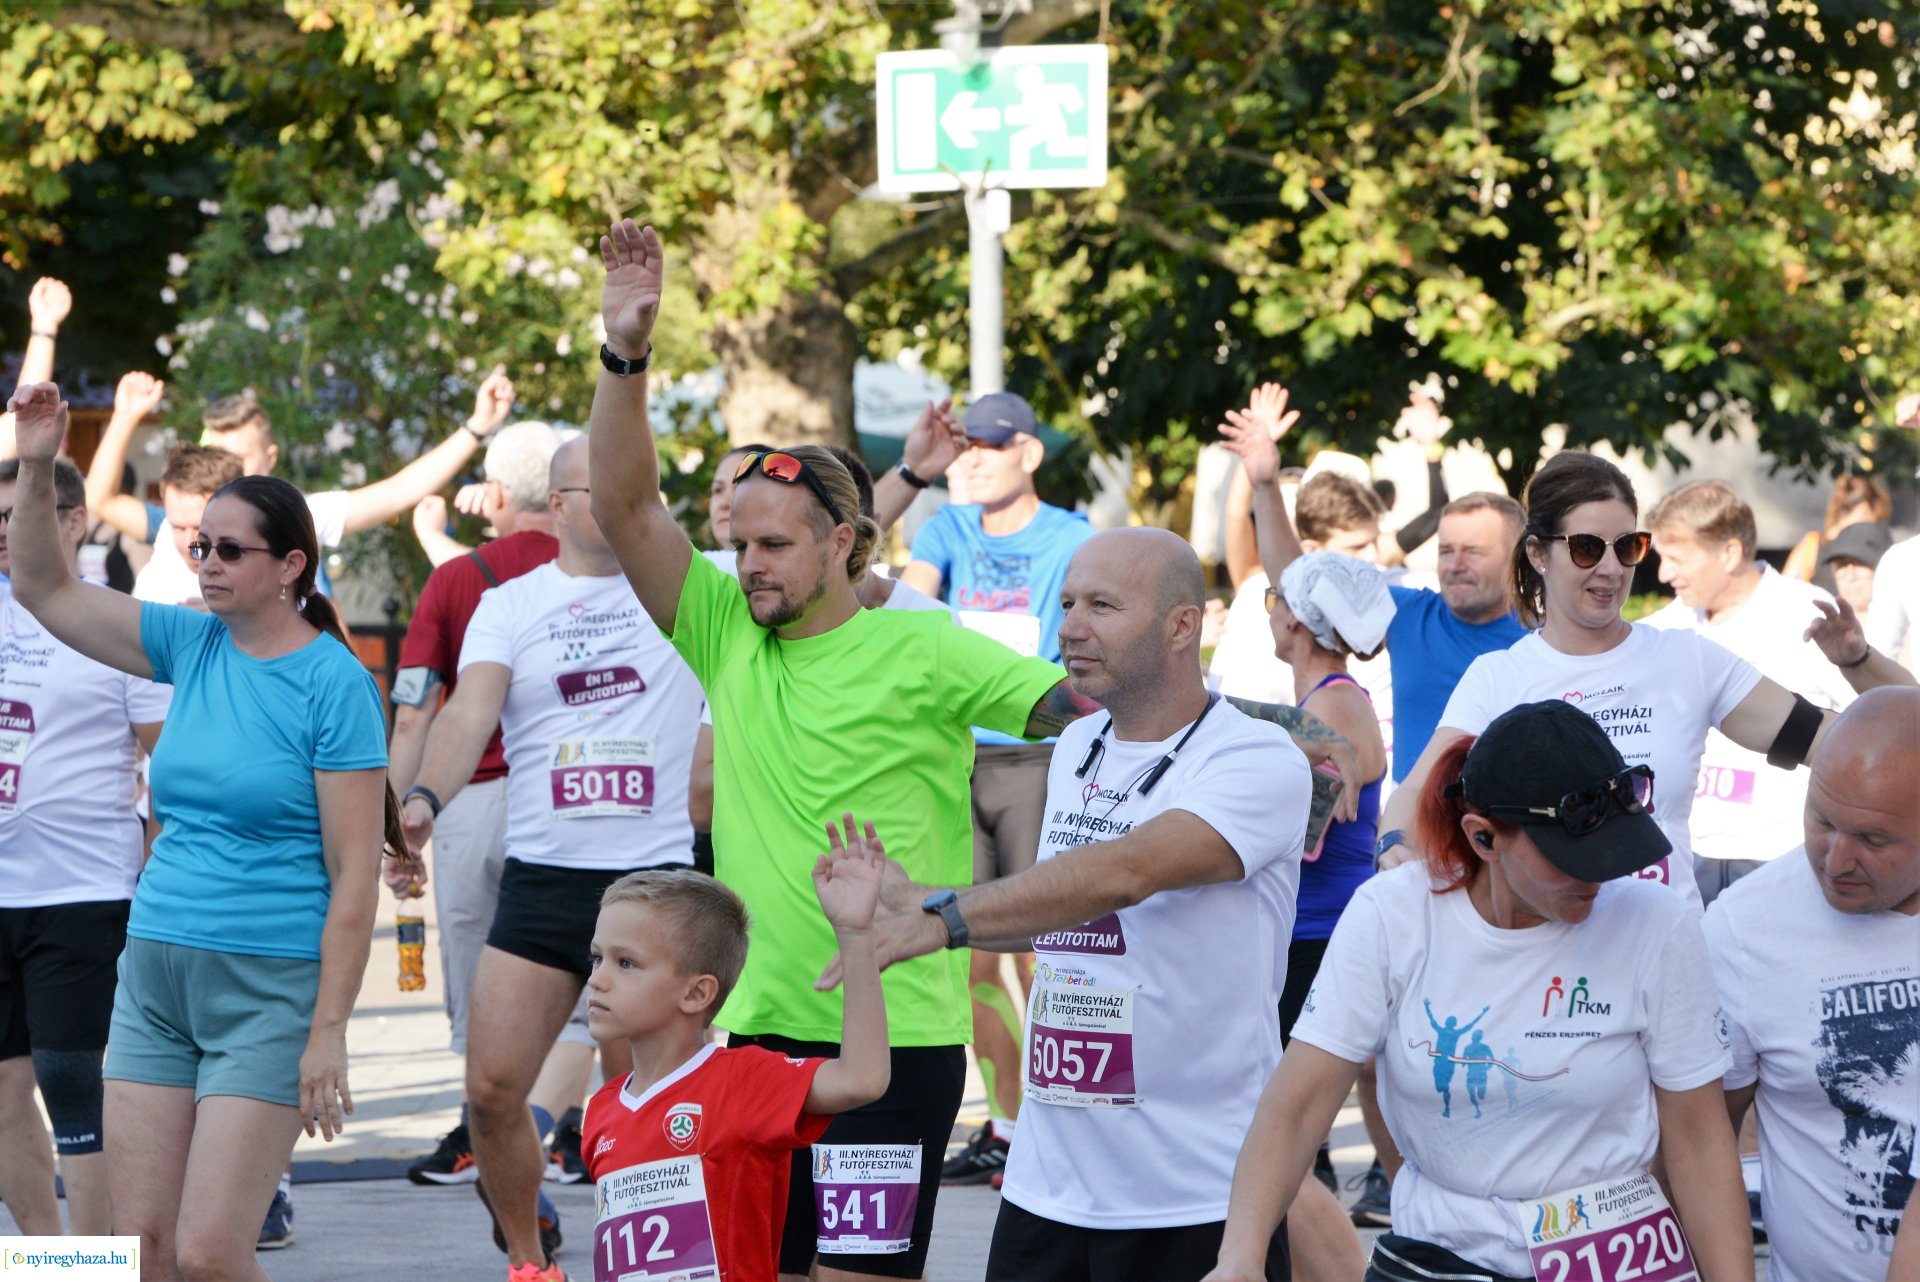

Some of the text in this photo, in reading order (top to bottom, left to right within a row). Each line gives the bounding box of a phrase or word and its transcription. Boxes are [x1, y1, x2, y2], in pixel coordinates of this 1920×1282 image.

[550, 621, 637, 641] FUTÓFESZTIVÁL
[585, 671, 615, 688] ÉN IS
[1584, 685, 1624, 699] MOZAIK
[567, 680, 641, 705] LEFUTOTTAM
[563, 769, 644, 802] 5018
[1052, 973, 1097, 987] Többet ad!
[1052, 1003, 1122, 1019] FUTÓFESZTIVÁL
[1577, 1000, 1611, 1016] TKM
[1820, 979, 1920, 1020] CALIFOR
[1525, 1031, 1602, 1039] PÉNZES ERZSÉBET
[1033, 1033, 1113, 1083] 5057
[839, 1158, 914, 1170] FUTÓFESZTIVÁL
[614, 1175, 691, 1201] FUTÓFESZTIVÁL
[1598, 1186, 1657, 1214] FUTÓFESZTIVÁL
[823, 1189, 886, 1230] 541
[602, 1214, 675, 1272] 112
[1540, 1216, 1685, 1282] 21220
